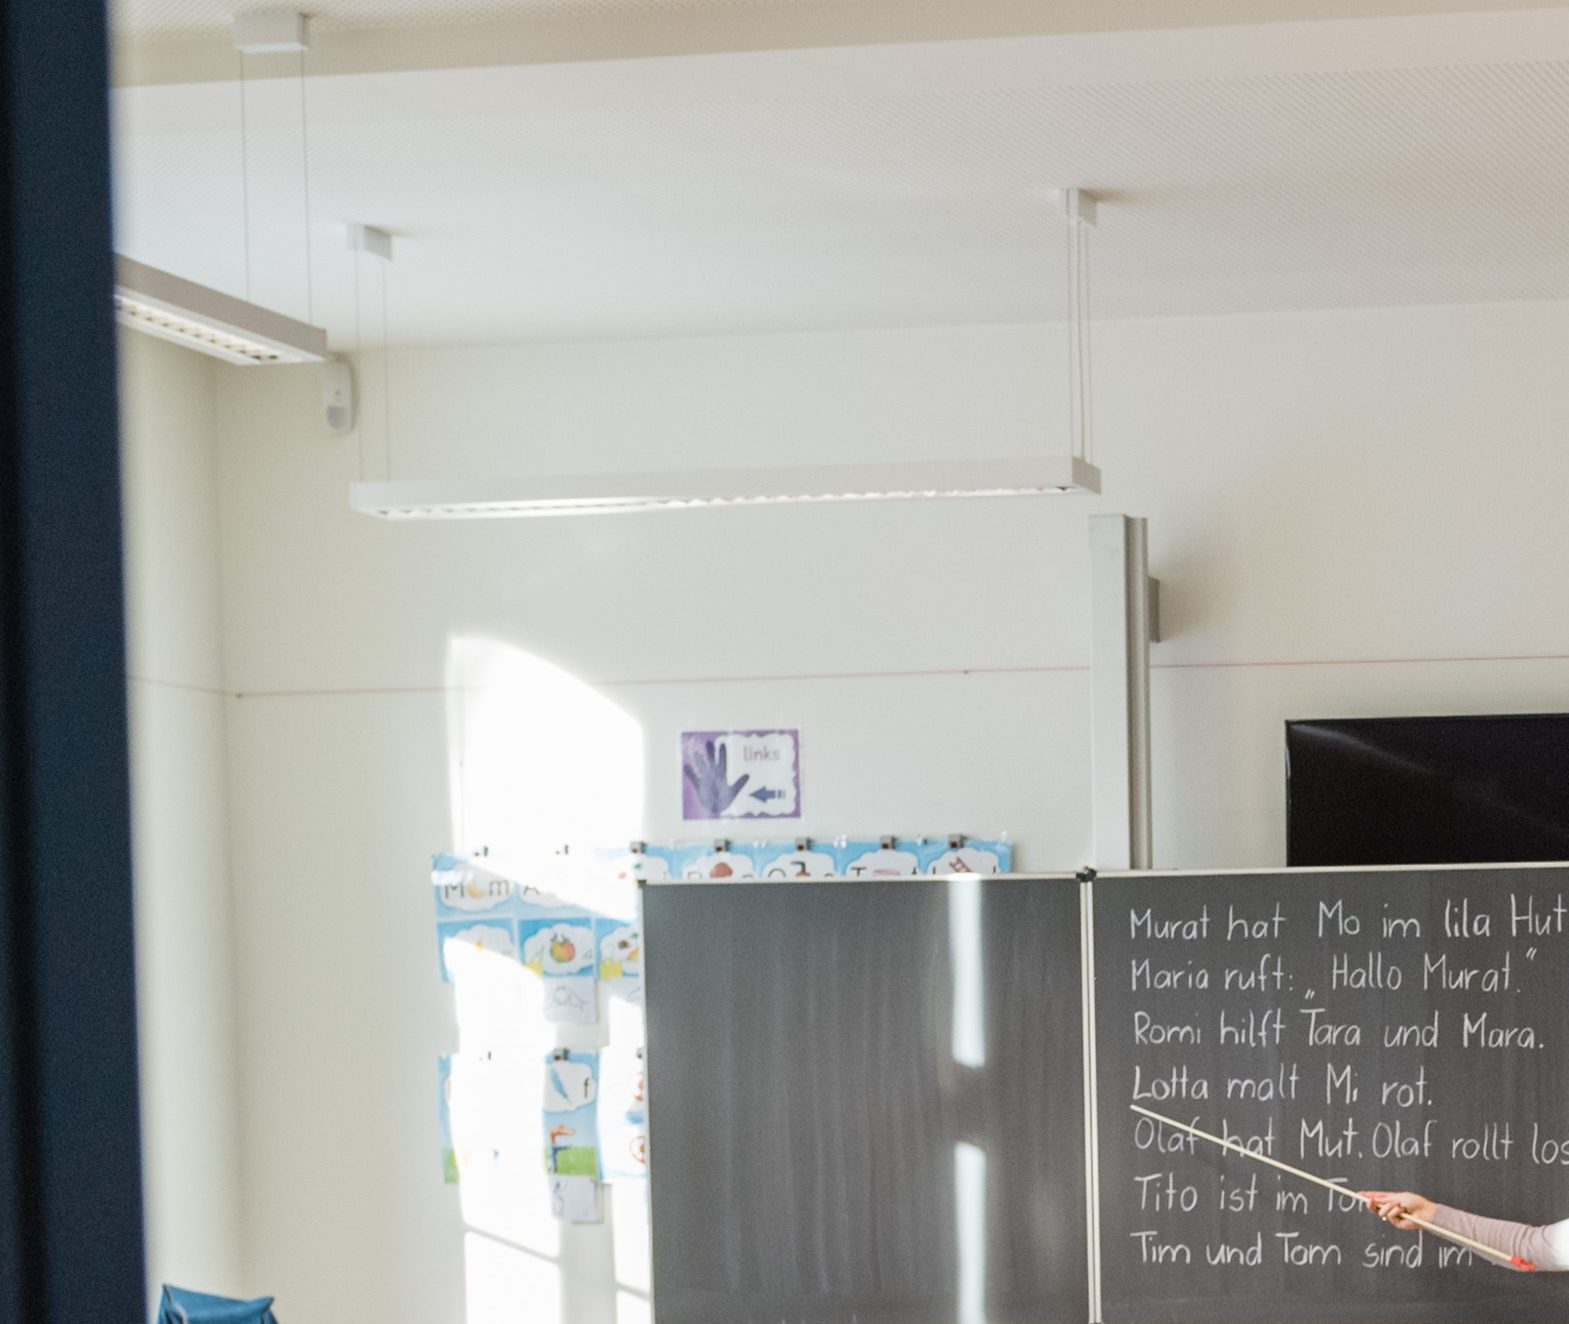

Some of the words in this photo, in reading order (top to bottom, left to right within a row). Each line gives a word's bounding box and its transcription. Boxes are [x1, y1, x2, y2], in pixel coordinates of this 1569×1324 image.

[743, 745, 781, 763] links
[1130, 904, 1210, 940] Murat
[1226, 902, 1287, 941] hat
[1318, 899, 1361, 938] Mo
[1382, 902, 1421, 938] im
[1444, 898, 1491, 938] lila
[1131, 957, 1209, 991] Maria
[1224, 953, 1294, 992] ruft:
[1134, 1010, 1201, 1045] Romi
[1220, 1008, 1287, 1048] hilft
[1299, 1008, 1361, 1047] Tara
[1384, 1010, 1439, 1048] und
[1463, 1012, 1545, 1049] Mara.
[1132, 1064, 1209, 1101] Lotta
[1227, 1062, 1299, 1101] malt
[1326, 1062, 1359, 1105] Mi
[1381, 1065, 1433, 1107] rot.
[1134, 1116, 1201, 1156] Olaf
[1221, 1116, 1275, 1158] hat
[1300, 1116, 1363, 1160] Mut.
[1372, 1119, 1438, 1158] Olaf
[1451, 1121, 1514, 1161] rollt
[1133, 1171, 1198, 1213] Tito
[1219, 1173, 1258, 1212] ist
[1276, 1174, 1309, 1215] im
[1129, 1231, 1192, 1265] Tim
[1206, 1231, 1262, 1267] und
[1274, 1231, 1342, 1266] Tom
[1362, 1229, 1424, 1269] sind
